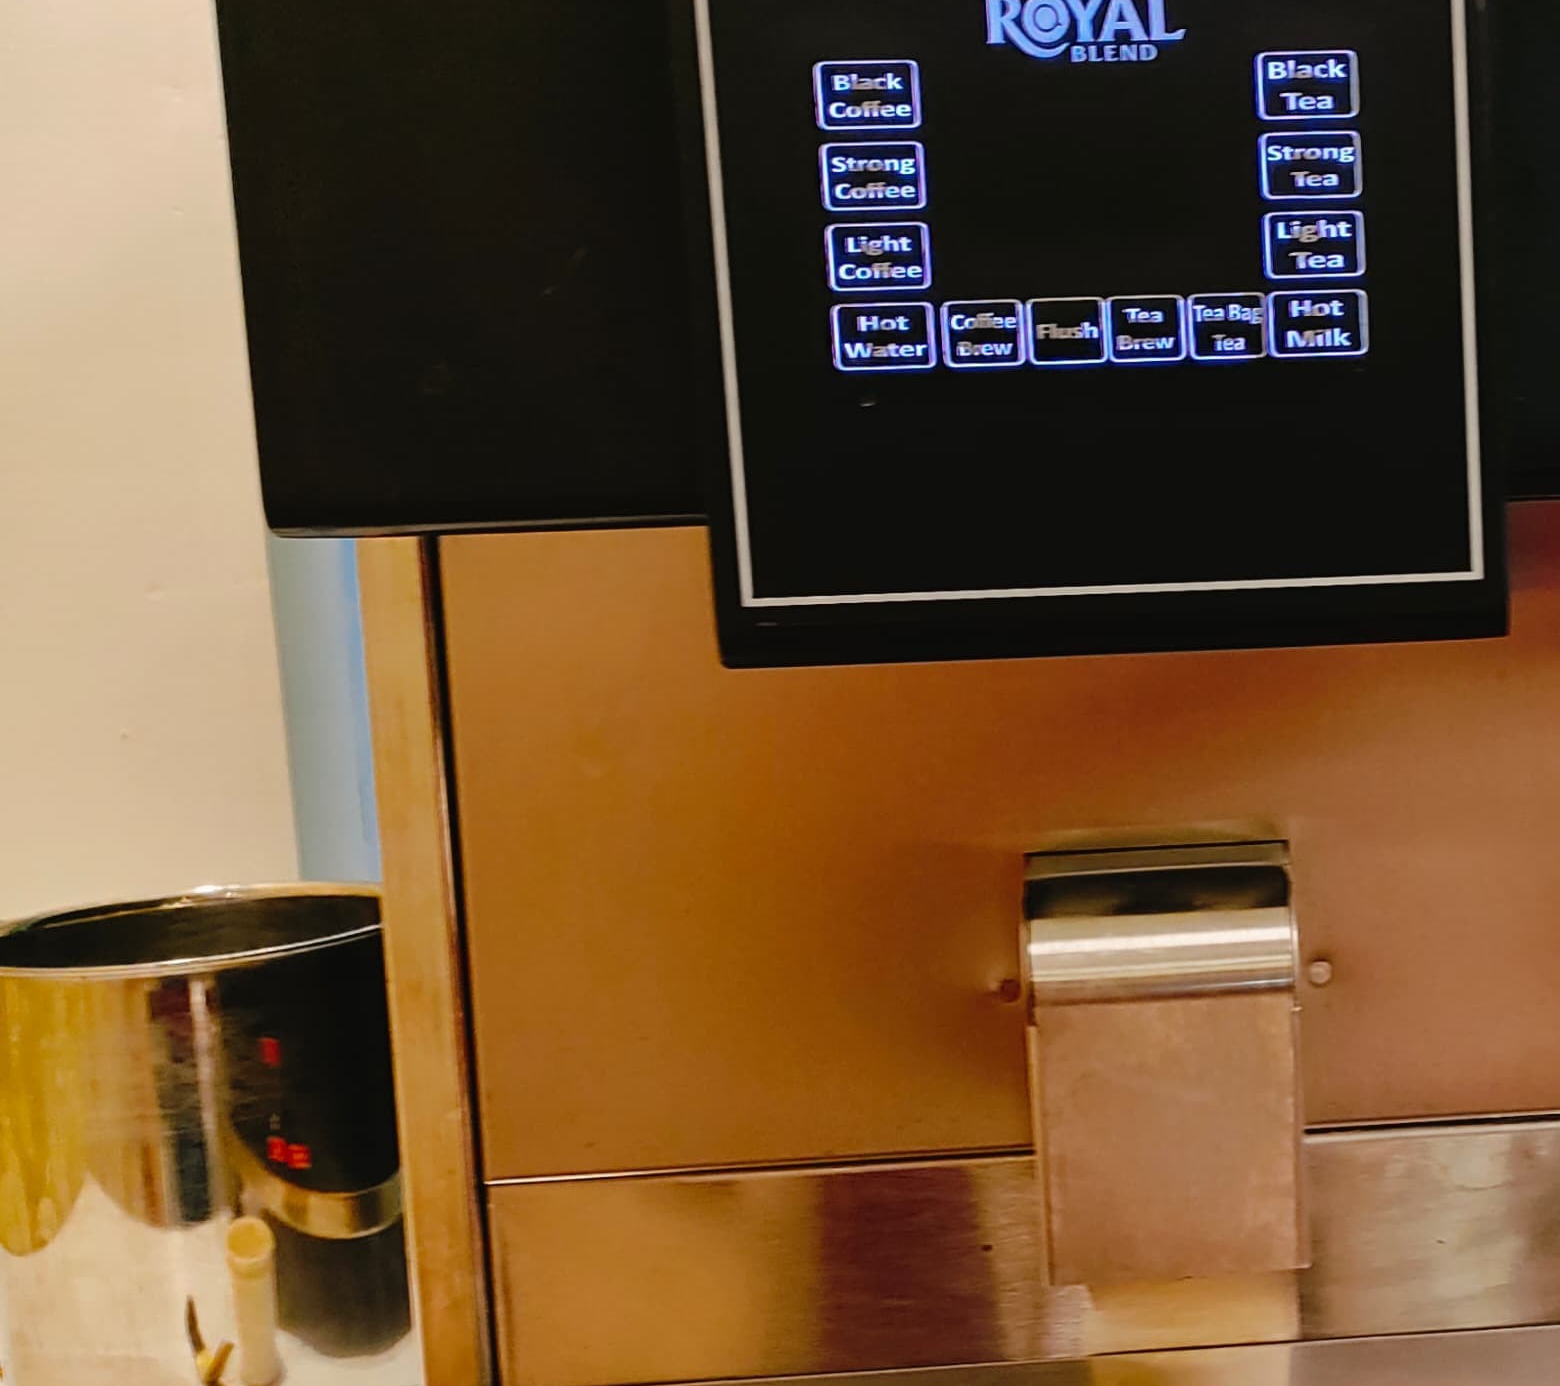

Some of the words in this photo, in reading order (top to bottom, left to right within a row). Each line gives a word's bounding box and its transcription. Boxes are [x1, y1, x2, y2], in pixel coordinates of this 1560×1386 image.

[1070, 44, 1158, 63] BLEND
[1266, 59, 1348, 80] Black
[831, 73, 904, 91] Black
[828, 100, 912, 118] Coffee
[1279, 92, 1335, 111] Tea
[1267, 145, 1355, 163] Strong
[831, 156, 916, 175] Strong
[1289, 170, 1340, 187] Tea
[834, 182, 916, 199] Coffee
[1276, 219, 1353, 243] Light
[844, 235, 912, 256] Light
[1288, 251, 1345, 269] Tea
[838, 262, 923, 280] Coffee
[1122, 307, 1164, 324] Tea
[1192, 305, 1225, 322] Tea
[1227, 303, 1265, 325] Bag
[1288, 299, 1345, 318] Hot
[856, 315, 911, 332] Hot
[950, 312, 1017, 330] Coffee
[1035, 322, 1099, 340] Flush
[1284, 327, 1353, 348] Milk
[843, 343, 928, 359] Water
[956, 341, 1014, 357] Brew
[1116, 334, 1176, 351] Brew
[1211, 333, 1246, 351] Tea
